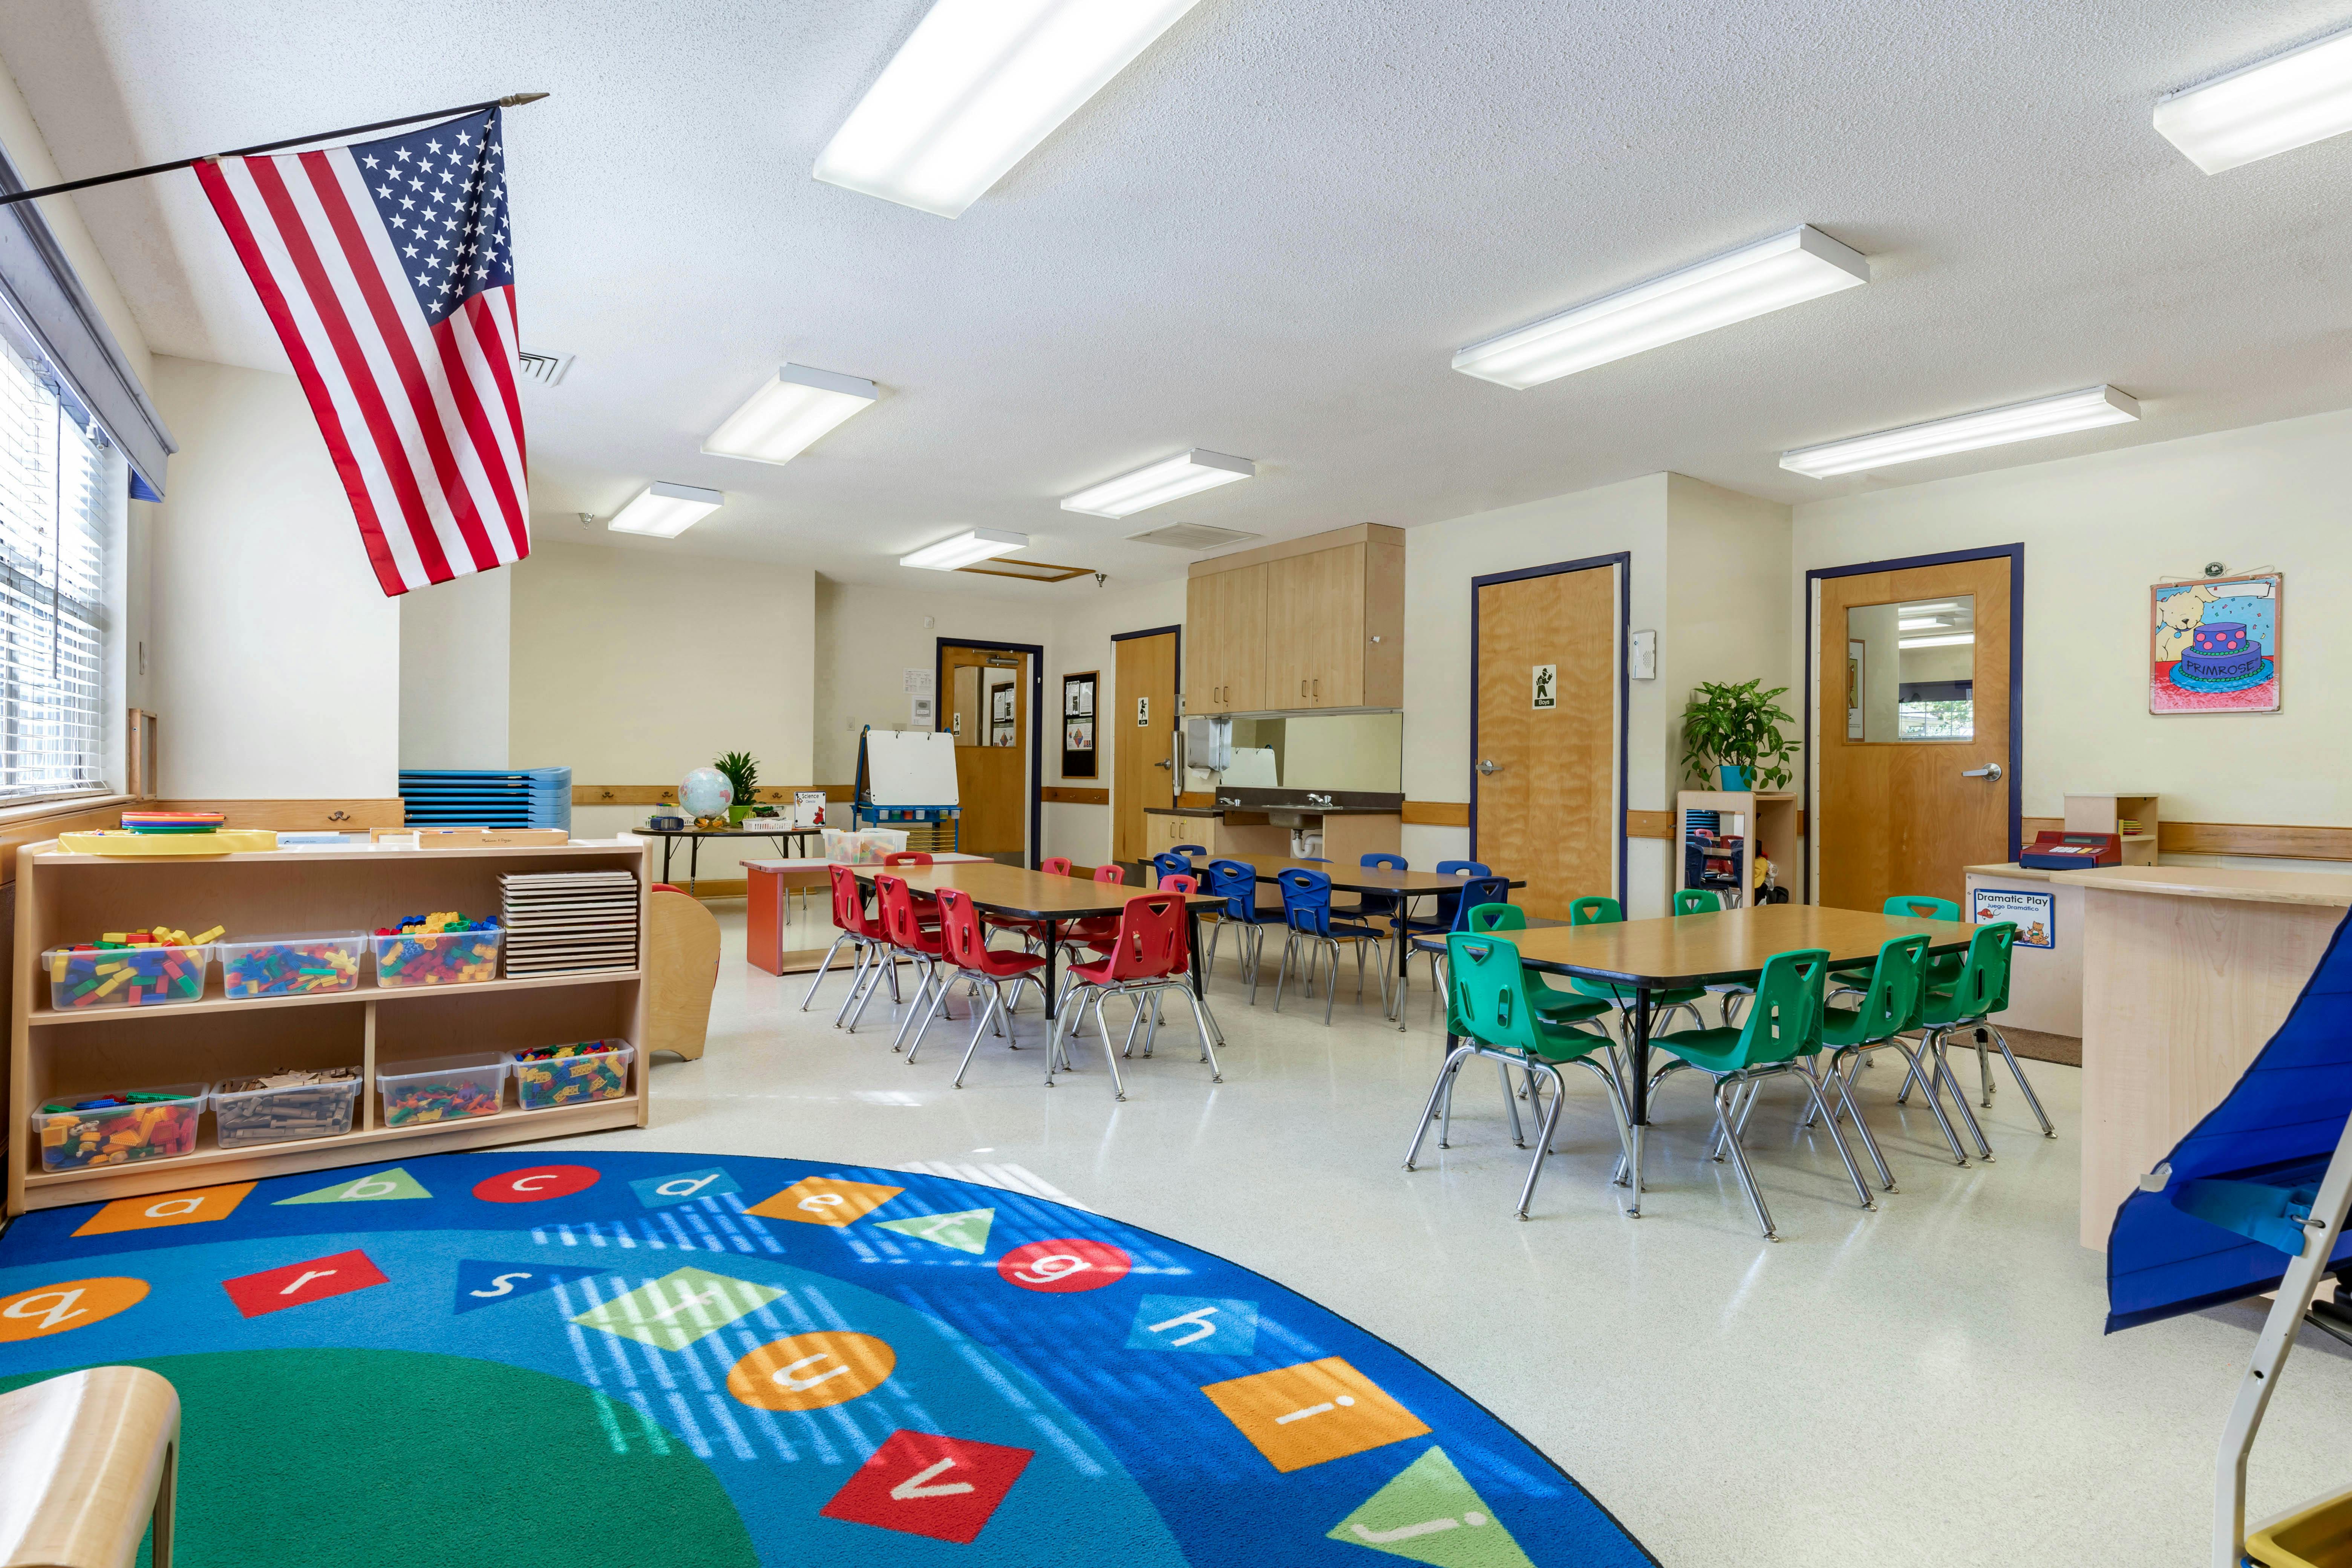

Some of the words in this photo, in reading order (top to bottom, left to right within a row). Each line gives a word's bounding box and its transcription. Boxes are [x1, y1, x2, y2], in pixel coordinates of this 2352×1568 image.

[1977, 893, 2023, 903] Dramatic
[2027, 896, 2048, 906] Play
[338, 1176, 397, 1199] b
[512, 1175, 557, 1191] c
[656, 1174, 718, 1196] d
[144, 1197, 205, 1217] a
[798, 1193, 844, 1213] e
[920, 1213, 982, 1236] f
[1015, 1254, 1092, 1283] g
[279, 1270, 337, 1295] r
[470, 1272, 532, 1297] s
[3, 1288, 88, 1329] q
[1148, 1307, 1218, 1346] h
[772, 1353, 850, 1392] u
[1276, 1395, 1355, 1424] i
[890, 1458, 975, 1500] v
[1351, 1511, 1488, 1543] j
